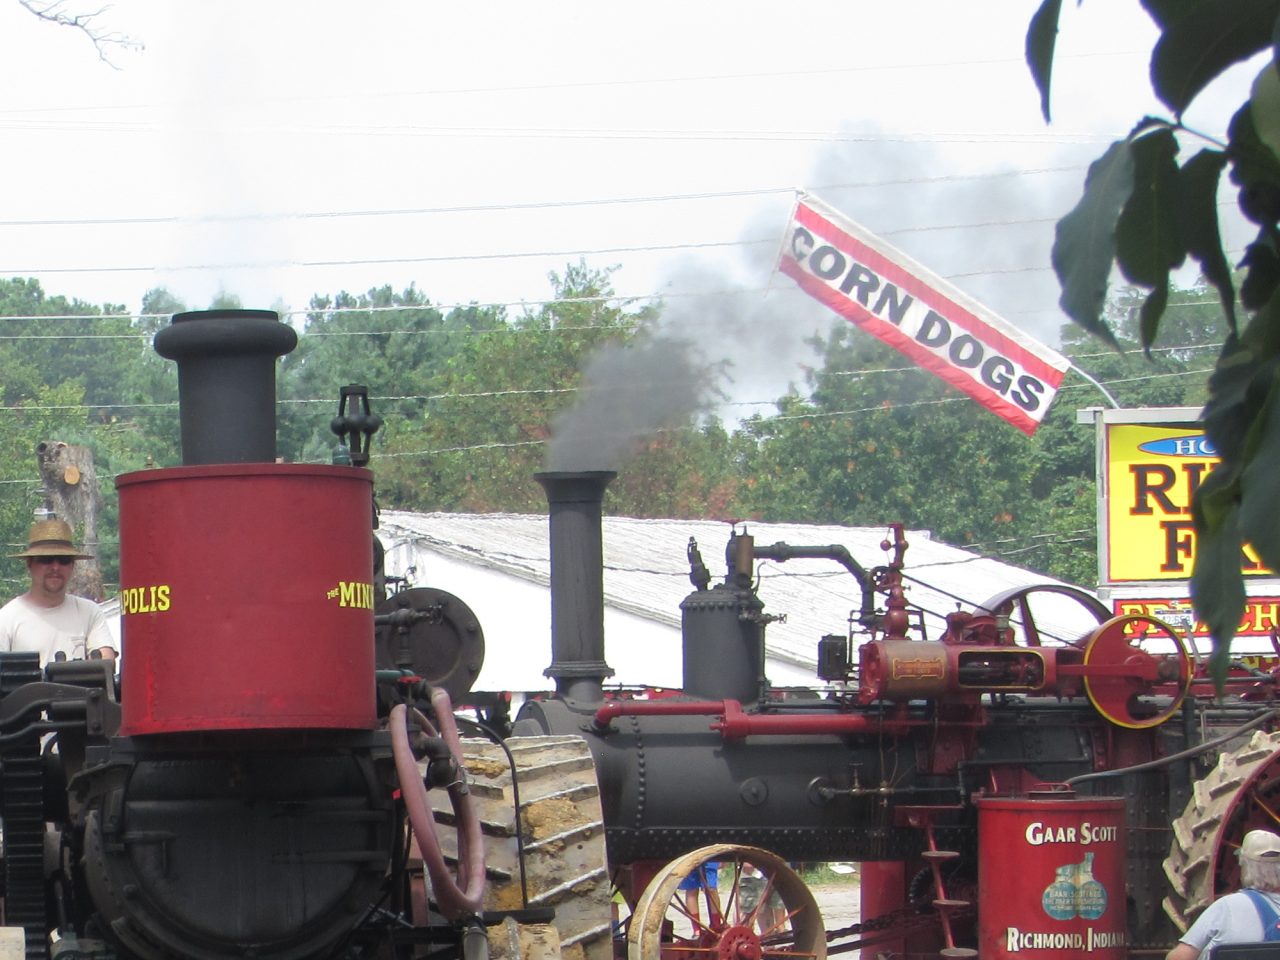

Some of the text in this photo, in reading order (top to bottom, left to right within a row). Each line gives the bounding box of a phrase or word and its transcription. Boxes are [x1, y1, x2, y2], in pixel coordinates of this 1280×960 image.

[792, 227, 1045, 412] CORN DOGS
[121, 584, 170, 615] POLIS
[1025, 822, 1117, 845] GAAR SCOTT
[1007, 927, 1086, 952] RICHMOND,
